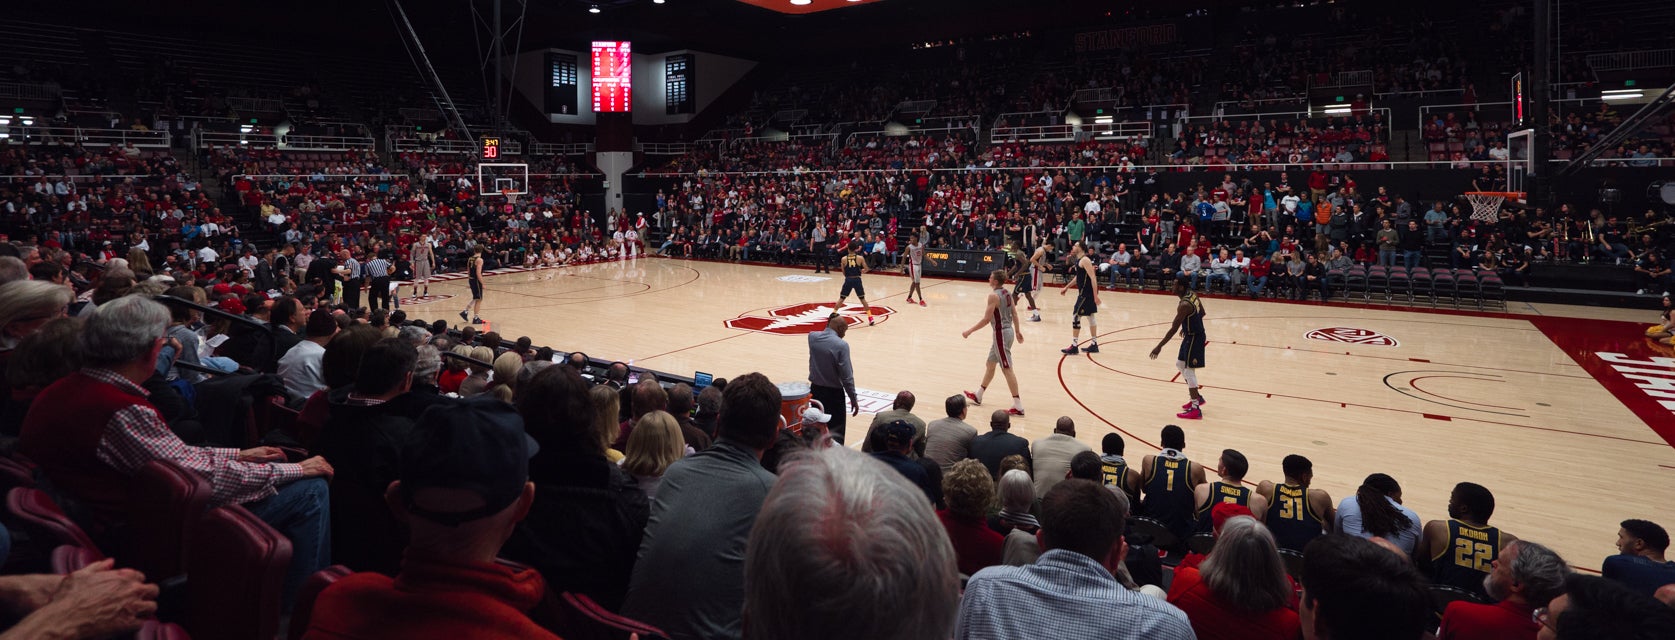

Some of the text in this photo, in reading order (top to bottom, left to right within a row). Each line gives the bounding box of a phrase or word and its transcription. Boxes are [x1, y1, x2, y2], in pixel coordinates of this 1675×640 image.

[1074, 23, 1176, 52] STANFORD
[484, 146, 496, 158] 30
[1166, 469, 1174, 491] 1
[1220, 485, 1241, 496] SINGER
[1279, 494, 1304, 521] 31
[1455, 538, 1492, 573] 22
